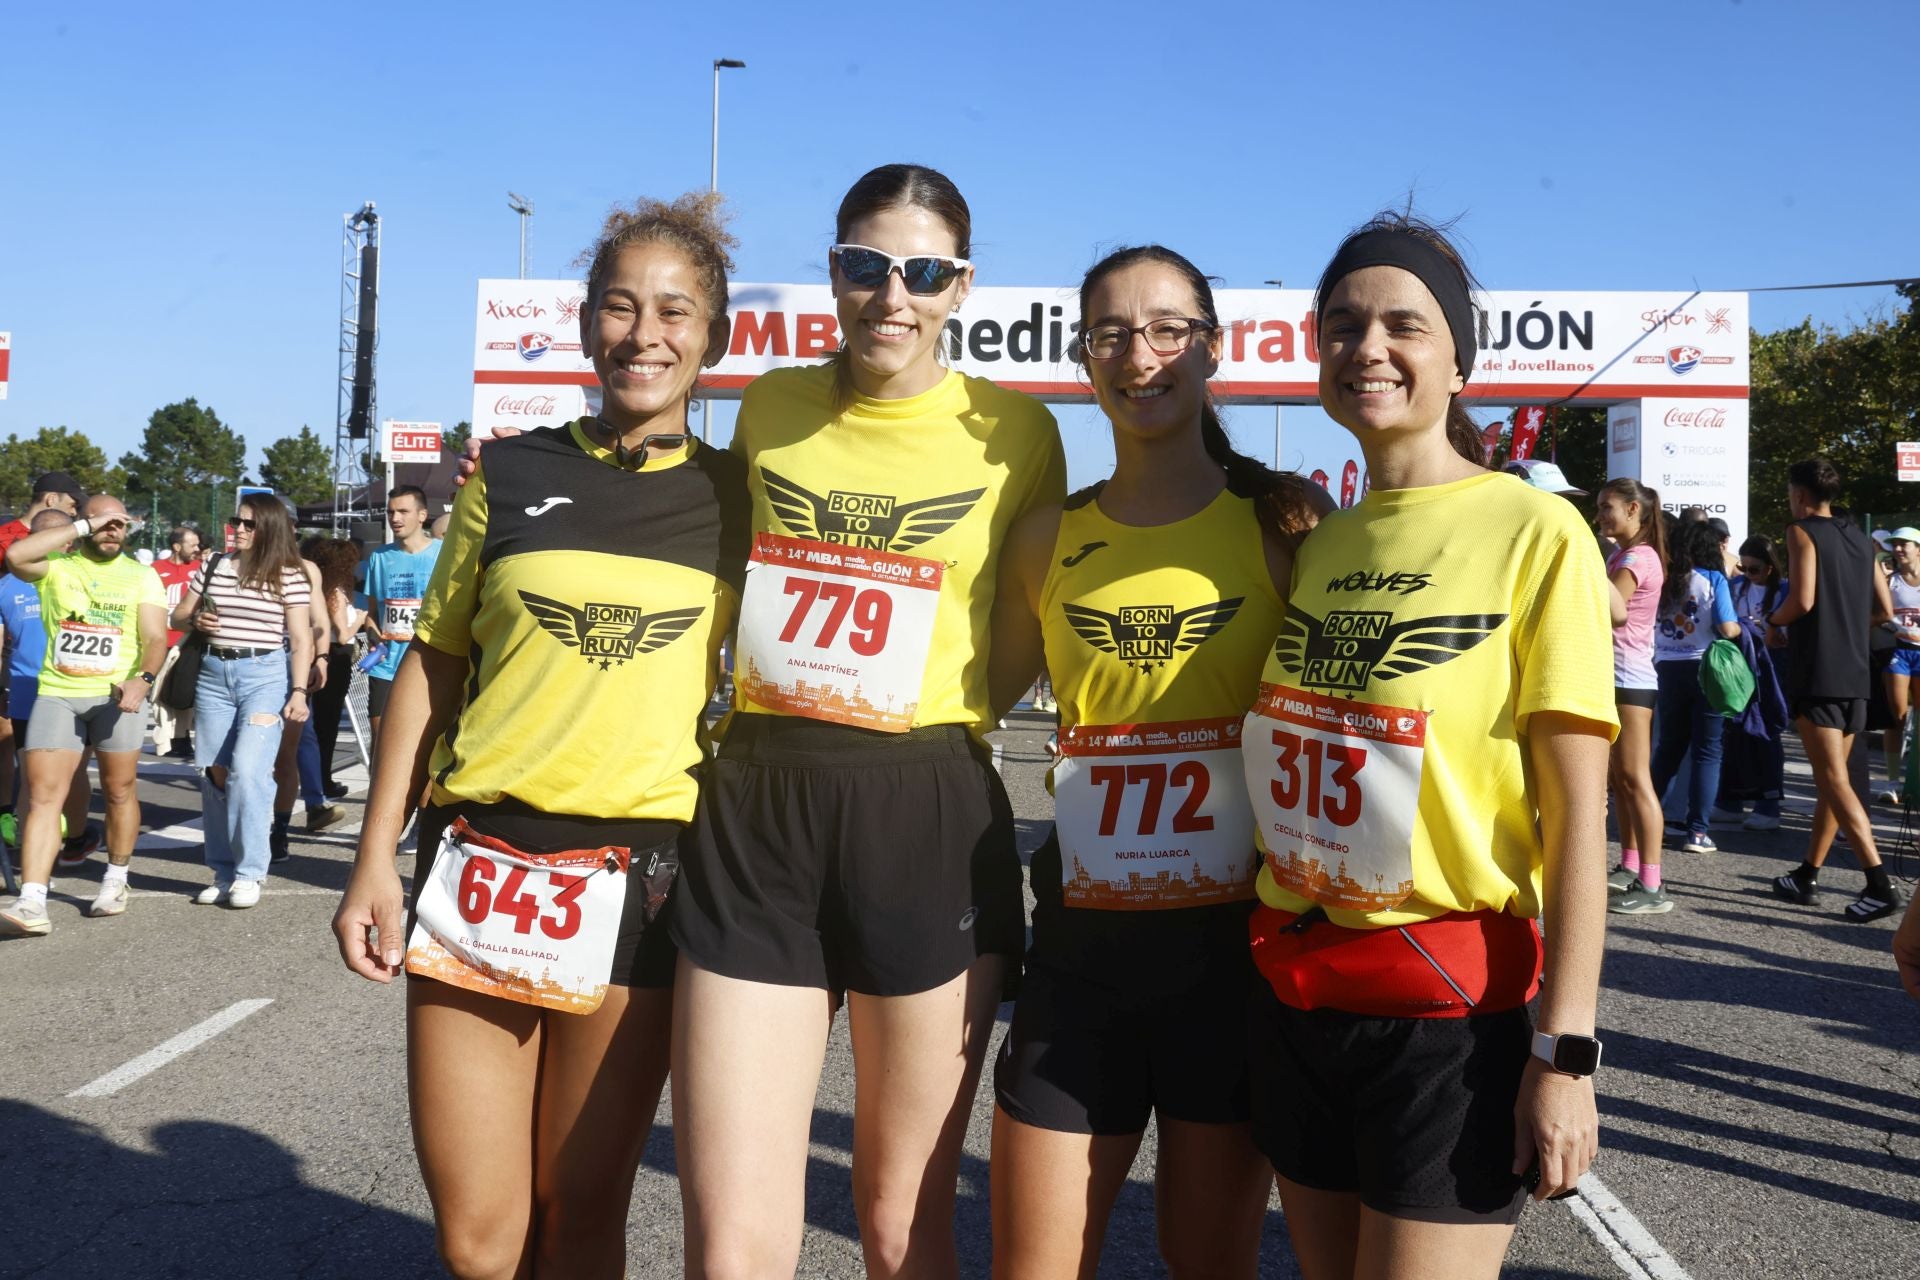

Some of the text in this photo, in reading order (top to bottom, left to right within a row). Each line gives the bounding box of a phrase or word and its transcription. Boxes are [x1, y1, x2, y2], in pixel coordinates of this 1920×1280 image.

[728, 310, 840, 359] MB
[1478, 301, 1594, 351] IJÓN
[1482, 358, 1501, 372] de
[1507, 359, 1595, 373] Jovellanos
[394, 433, 436, 449] ÉLITE
[830, 494, 891, 518] BORN
[843, 516, 870, 531] TO
[806, 551, 843, 567] MBA
[872, 561, 913, 578] GIJÓN
[1326, 570, 1438, 595] WOLVES
[103, 602, 127, 612] GREAT
[588, 607, 637, 624] BORN
[778, 575, 893, 657] 779
[1122, 609, 1170, 624] BORN
[1134, 626, 1156, 638] TO
[1324, 615, 1387, 638] BORN
[60, 633, 114, 657] 2226
[584, 638, 633, 656] RUN
[1122, 640, 1170, 657] RUN
[1333, 640, 1358, 657] TO
[787, 658, 860, 677] ANA MARTÍNEZ
[1306, 660, 1368, 686] RUN
[1283, 700, 1314, 718] MBA
[1315, 706, 1336, 715] media
[1343, 713, 1388, 732] GIJÓN
[1106, 734, 1144, 747] MBA
[1178, 728, 1219, 743] GIJÓN
[1270, 728, 1368, 827] 313
[1090, 760, 1215, 836] 772
[1274, 822, 1350, 854] CECILIA CONEJERO
[1115, 849, 1191, 860] NURIA LUARCA
[457, 855, 588, 940] 643
[459, 936, 560, 962] EL GHALIA BALHADJ
